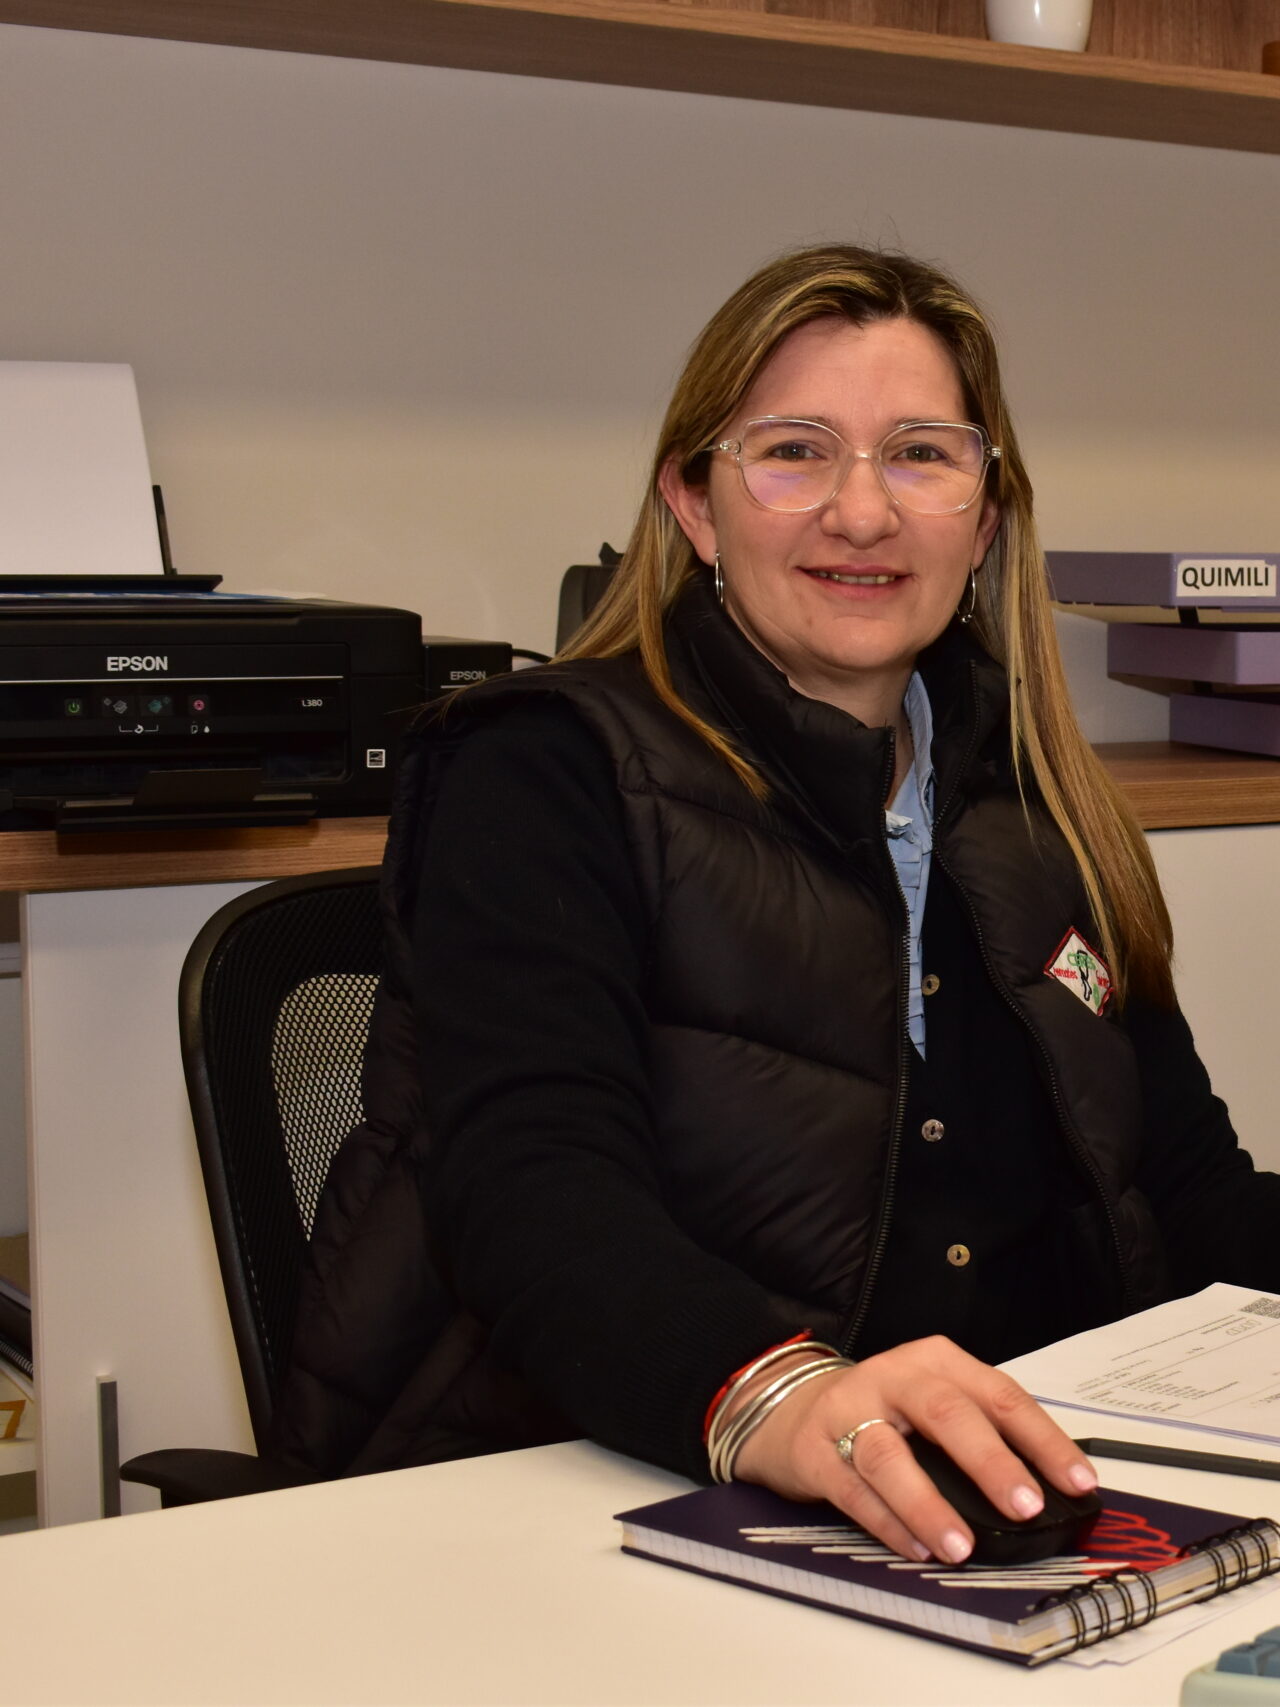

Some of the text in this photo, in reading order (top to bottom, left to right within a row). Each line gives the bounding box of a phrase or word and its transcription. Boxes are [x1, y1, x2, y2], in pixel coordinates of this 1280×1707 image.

[1181, 565, 1271, 589] QUIMILI
[106, 656, 169, 672] EPSON
[449, 670, 487, 681] EPSON
[301, 698, 323, 708] L380
